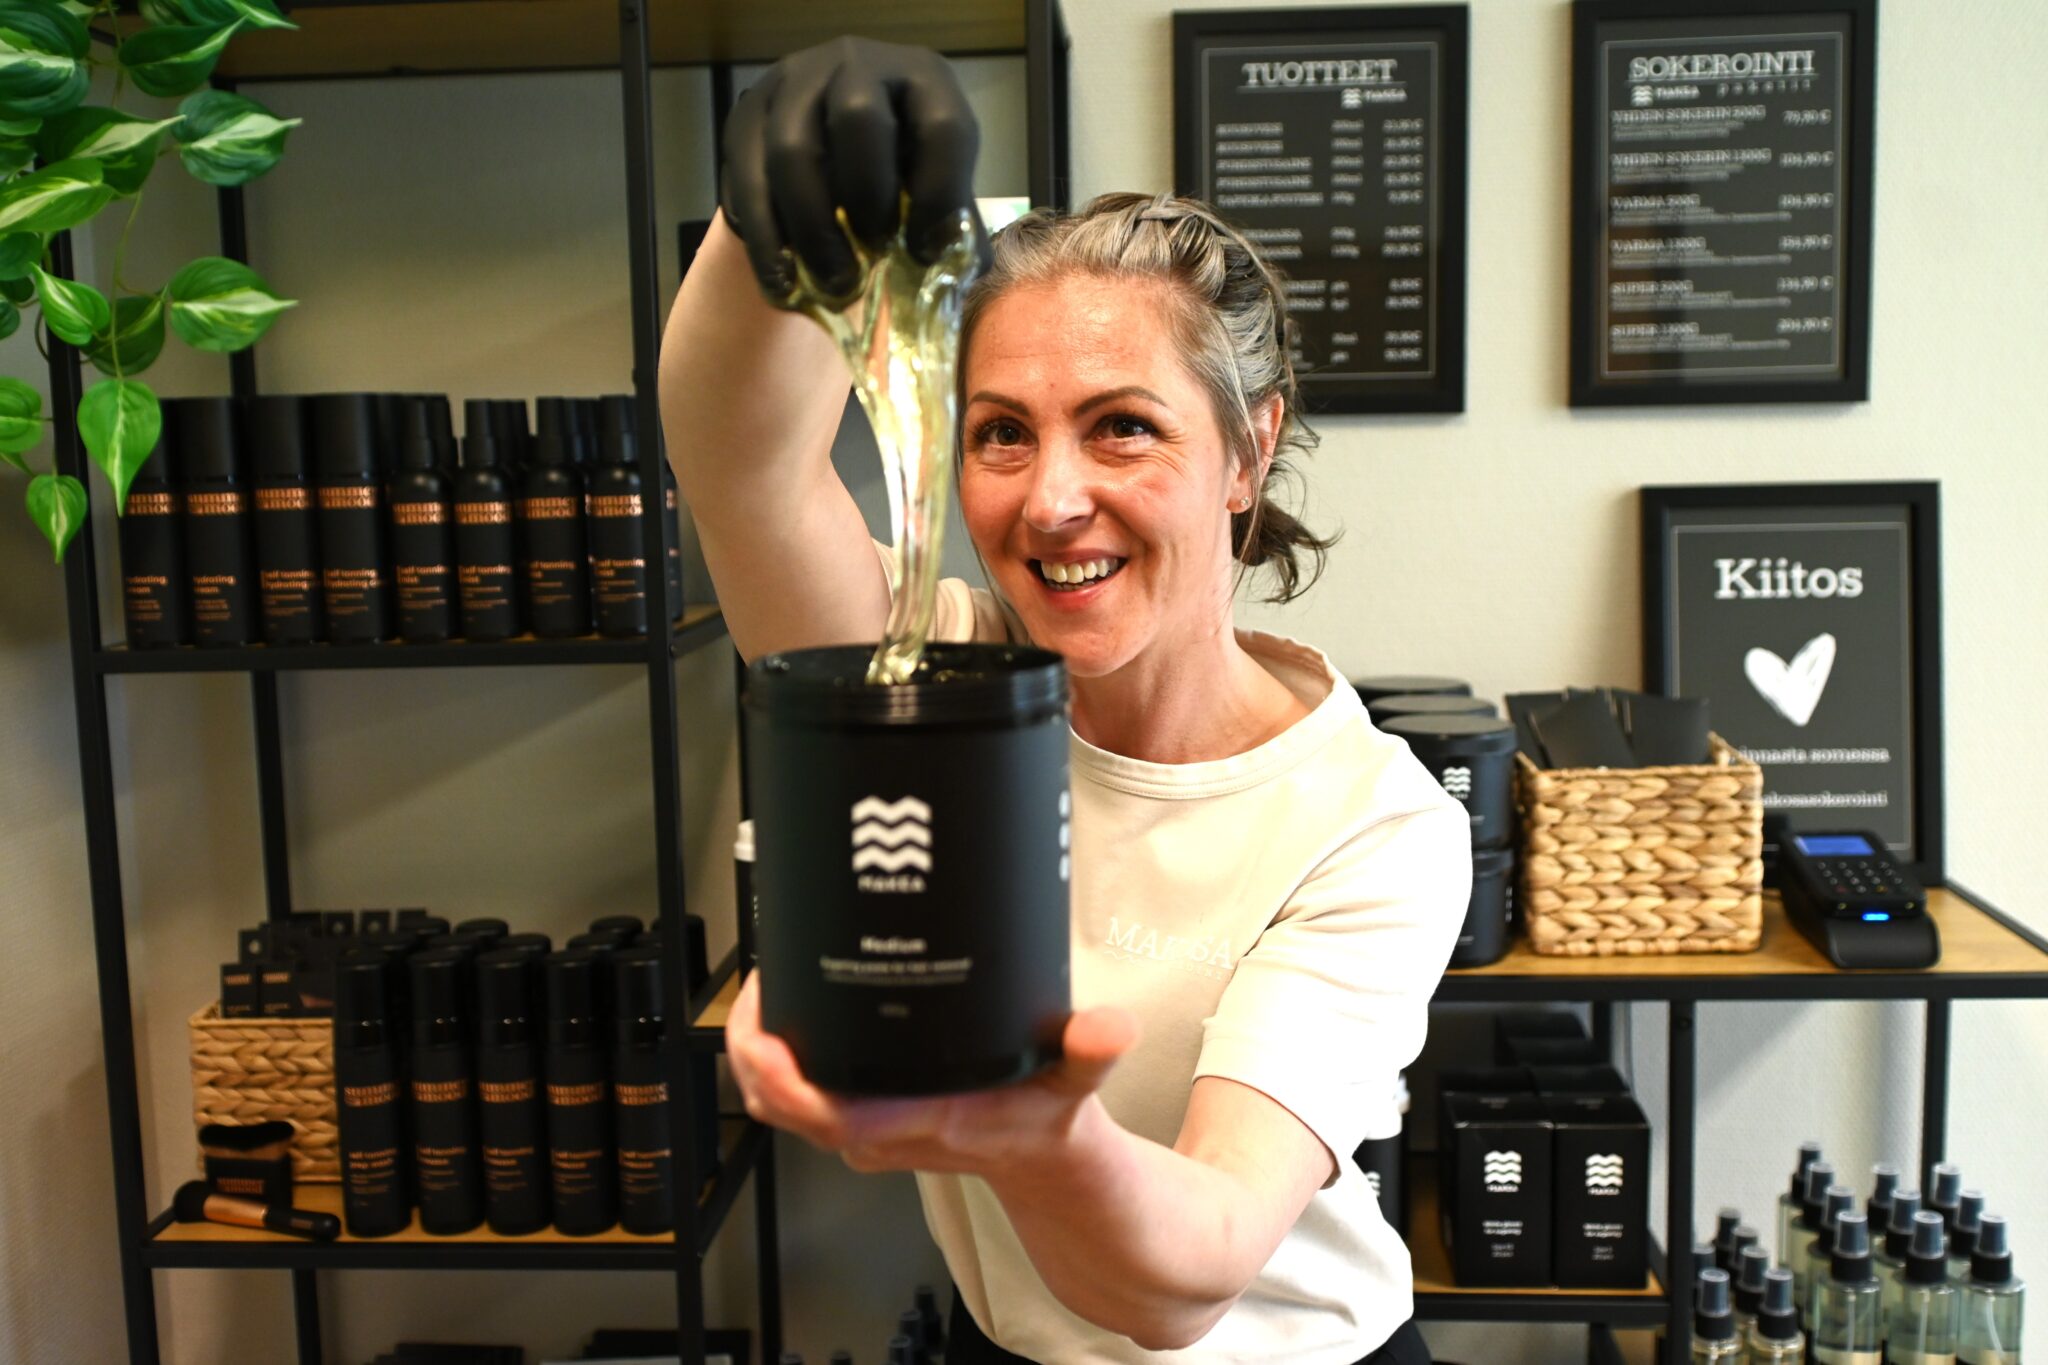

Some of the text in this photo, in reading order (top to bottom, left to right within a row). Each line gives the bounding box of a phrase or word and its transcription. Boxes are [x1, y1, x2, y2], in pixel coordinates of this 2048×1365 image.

[1242, 59, 1397, 87] TUOTTEET
[1630, 51, 1815, 80] SOKEROINTI
[1714, 558, 1863, 599] Kiitos
